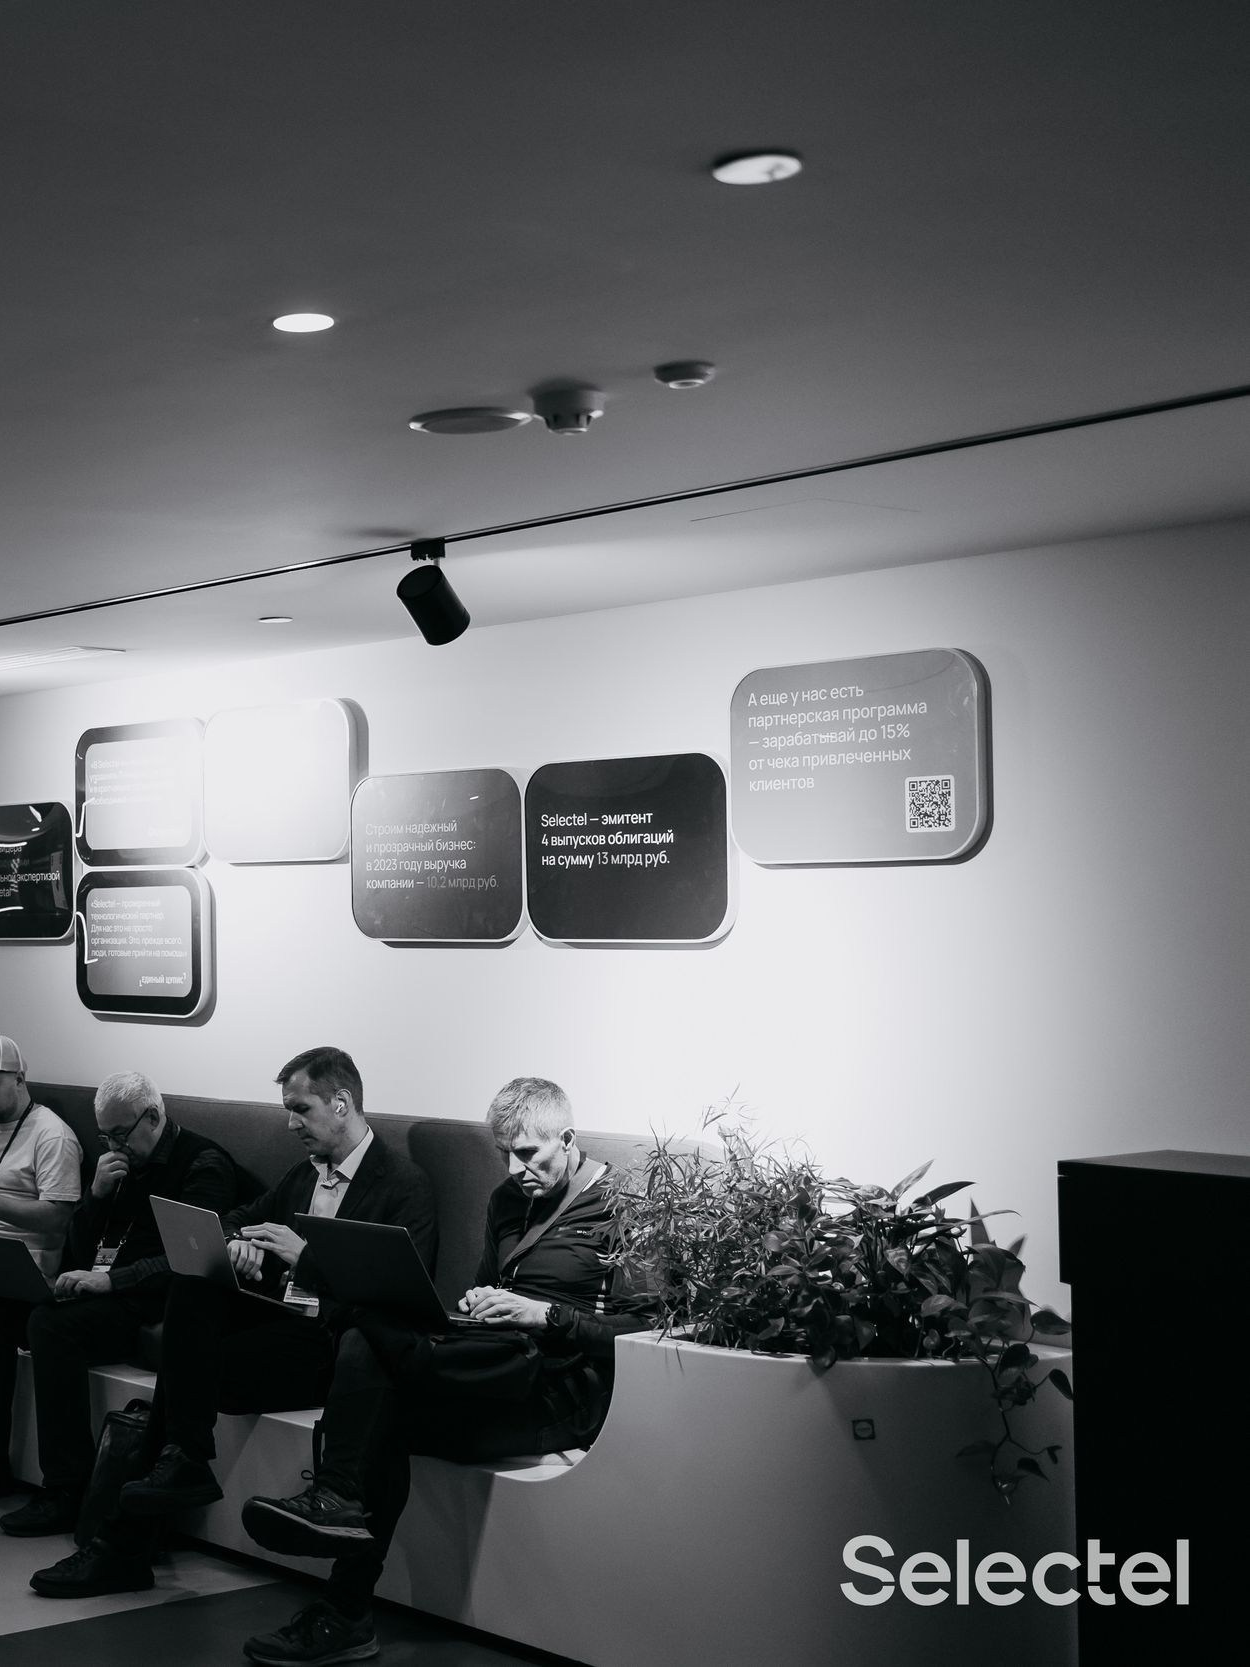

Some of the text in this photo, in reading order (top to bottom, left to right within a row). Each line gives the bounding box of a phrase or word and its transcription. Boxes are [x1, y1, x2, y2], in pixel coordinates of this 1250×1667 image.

[748, 686, 864, 707] А еще у нас есть
[748, 702, 927, 730] партнерская программа
[762, 728, 855, 750] зарабатывай
[858, 729, 877, 743] до
[880, 723, 910, 740] 15%
[748, 748, 912, 771] от чека привлеченных
[749, 778, 814, 792] клиентов
[541, 812, 588, 826] Selectel
[601, 813, 654, 825] эмитент
[366, 820, 458, 837] Строим надежный
[366, 838, 476, 856] и прозрачный бизнес:
[542, 829, 674, 849] 4 выпусков облигаций
[366, 858, 467, 874] в 2023 году выручка
[542, 850, 670, 869] на сумму 13 млрд руб.
[366, 878, 414, 889] компании
[448, 876, 476, 890] млрд
[478, 875, 500, 890] руб.
